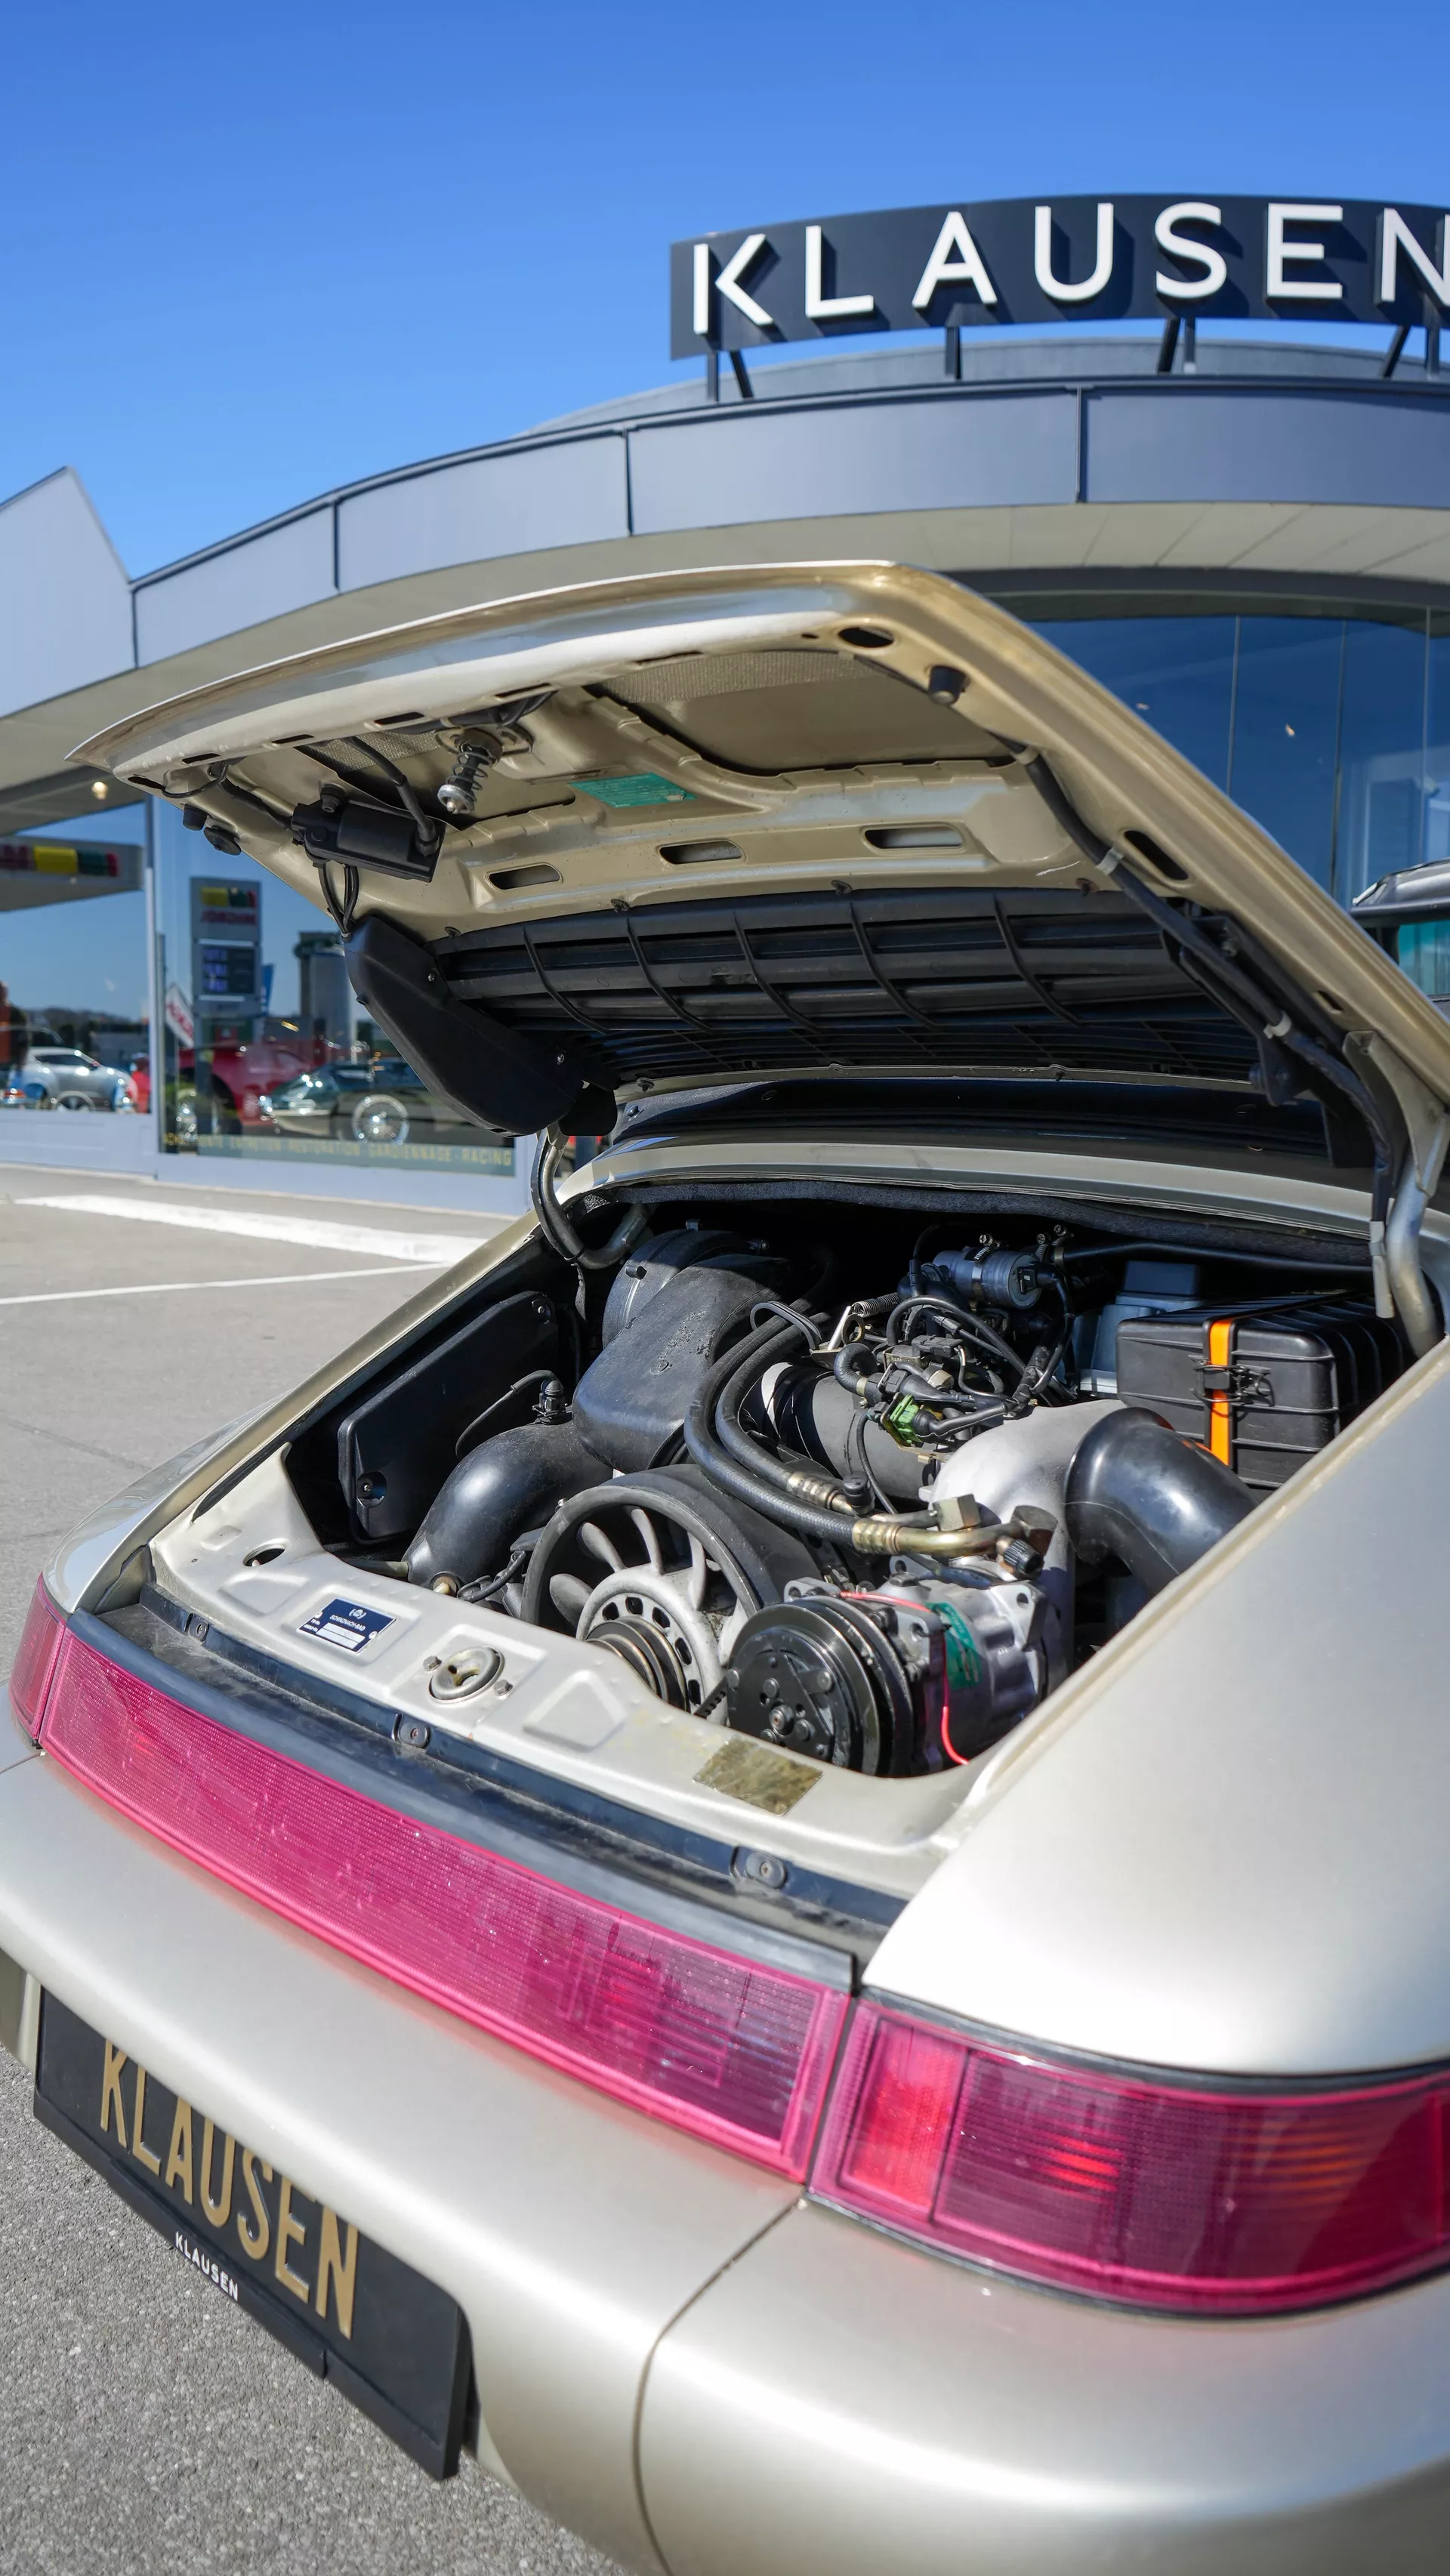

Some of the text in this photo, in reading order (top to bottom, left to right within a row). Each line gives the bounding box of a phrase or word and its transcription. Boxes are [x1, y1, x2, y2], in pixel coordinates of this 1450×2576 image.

[693, 201, 1450, 335] KLAUSEN
[461, 1147, 513, 1167] RACING
[100, 2038, 359, 2340] KLAUSEN
[174, 2230, 239, 2302] KLAUSEN
